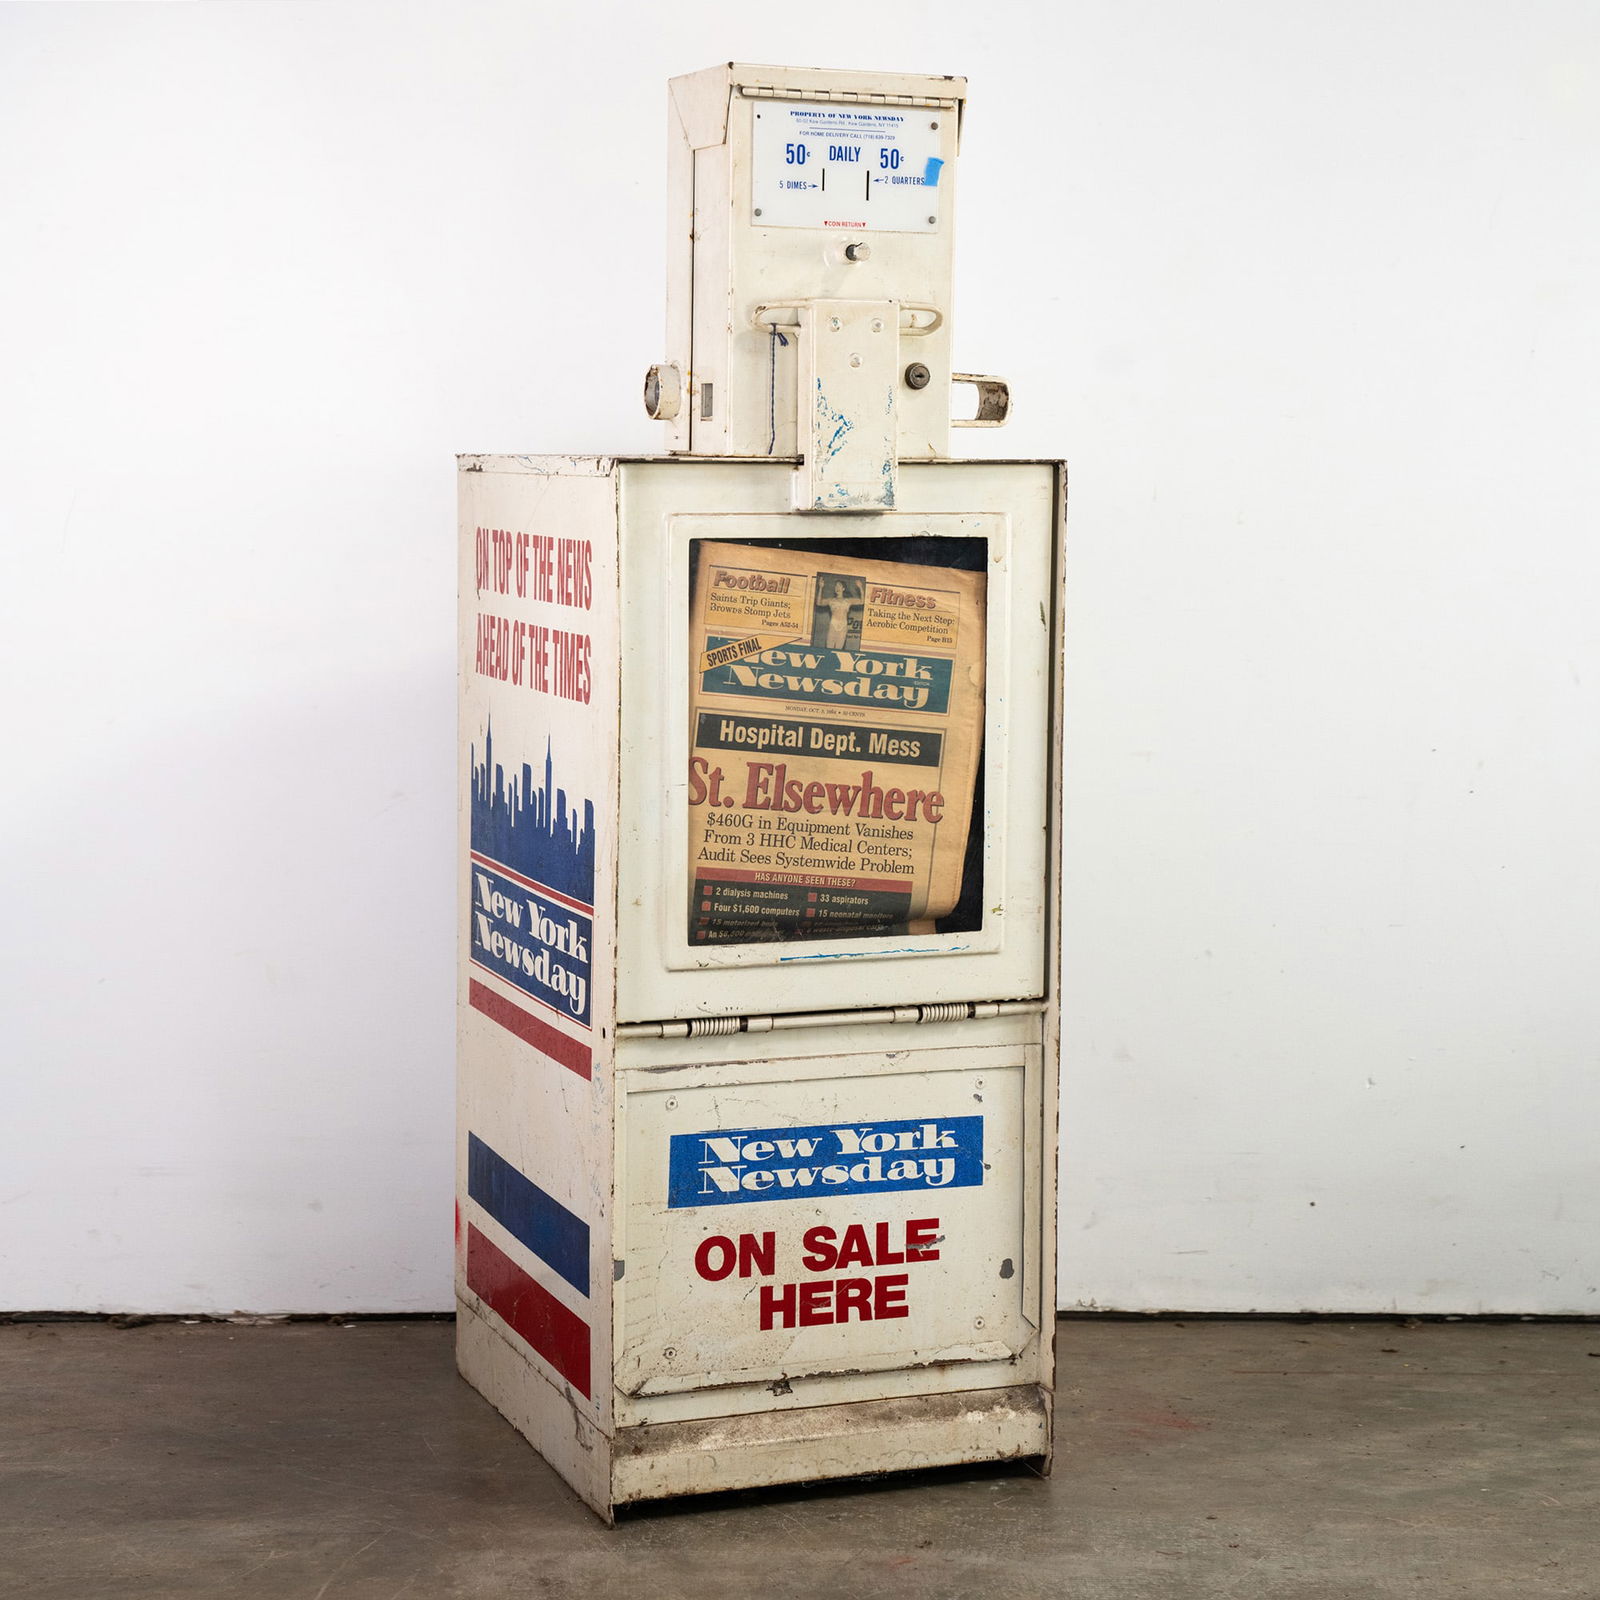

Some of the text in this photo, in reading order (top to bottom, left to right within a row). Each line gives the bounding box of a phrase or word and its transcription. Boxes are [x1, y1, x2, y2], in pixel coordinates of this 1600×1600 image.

[829, 146, 861, 162] DAILY
[780, 180, 807, 190] 5 DIMES
[884, 176, 925, 186] 2 QUARTERS
[476, 526, 592, 611] ON TOP OF THE NEWS
[714, 570, 791, 594] Football
[710, 592, 738, 604] Saints
[740, 596, 758, 606] Trip
[710, 602, 791, 619] Browns Stomp Jets
[869, 586, 936, 610] Fitness
[762, 619, 778, 627] Pages
[866, 618, 898, 629] Aerobic
[899, 622, 949, 635] Competition
[868, 608, 896, 620] Taking
[898, 611, 911, 620] the
[912, 613, 933, 622] Next
[706, 638, 762, 668] SPORTS FINAL
[927, 635, 941, 644] Page
[476, 612, 592, 706] AHEAD OF THE TIMES
[832, 652, 934, 681] York
[724, 664, 930, 710] Newsday
[720, 720, 922, 758] Hospital Dept. Mess
[688, 756, 946, 824] St. Elsewhere
[706, 812, 914, 841] $460G in Equipment Vanishes
[704, 829, 913, 859] From 3 HHC Medical Centers;
[698, 847, 915, 874] Audit Sees Systemwide Problem
[716, 887, 789, 900] 2 dialysis machines
[754, 872, 856, 888] HAS ANYONE SEEN THESE?
[714, 902, 732, 912] Four
[760, 904, 800, 917] computers
[820, 894, 869, 906] 33 aspirators
[475, 872, 588, 964] New York
[474, 910, 586, 1016] Newsday
[698, 1124, 959, 1164] New York
[698, 1156, 956, 1194] Newsday
[694, 1218, 940, 1282] ON SALE
[760, 1274, 909, 1331] HERE
